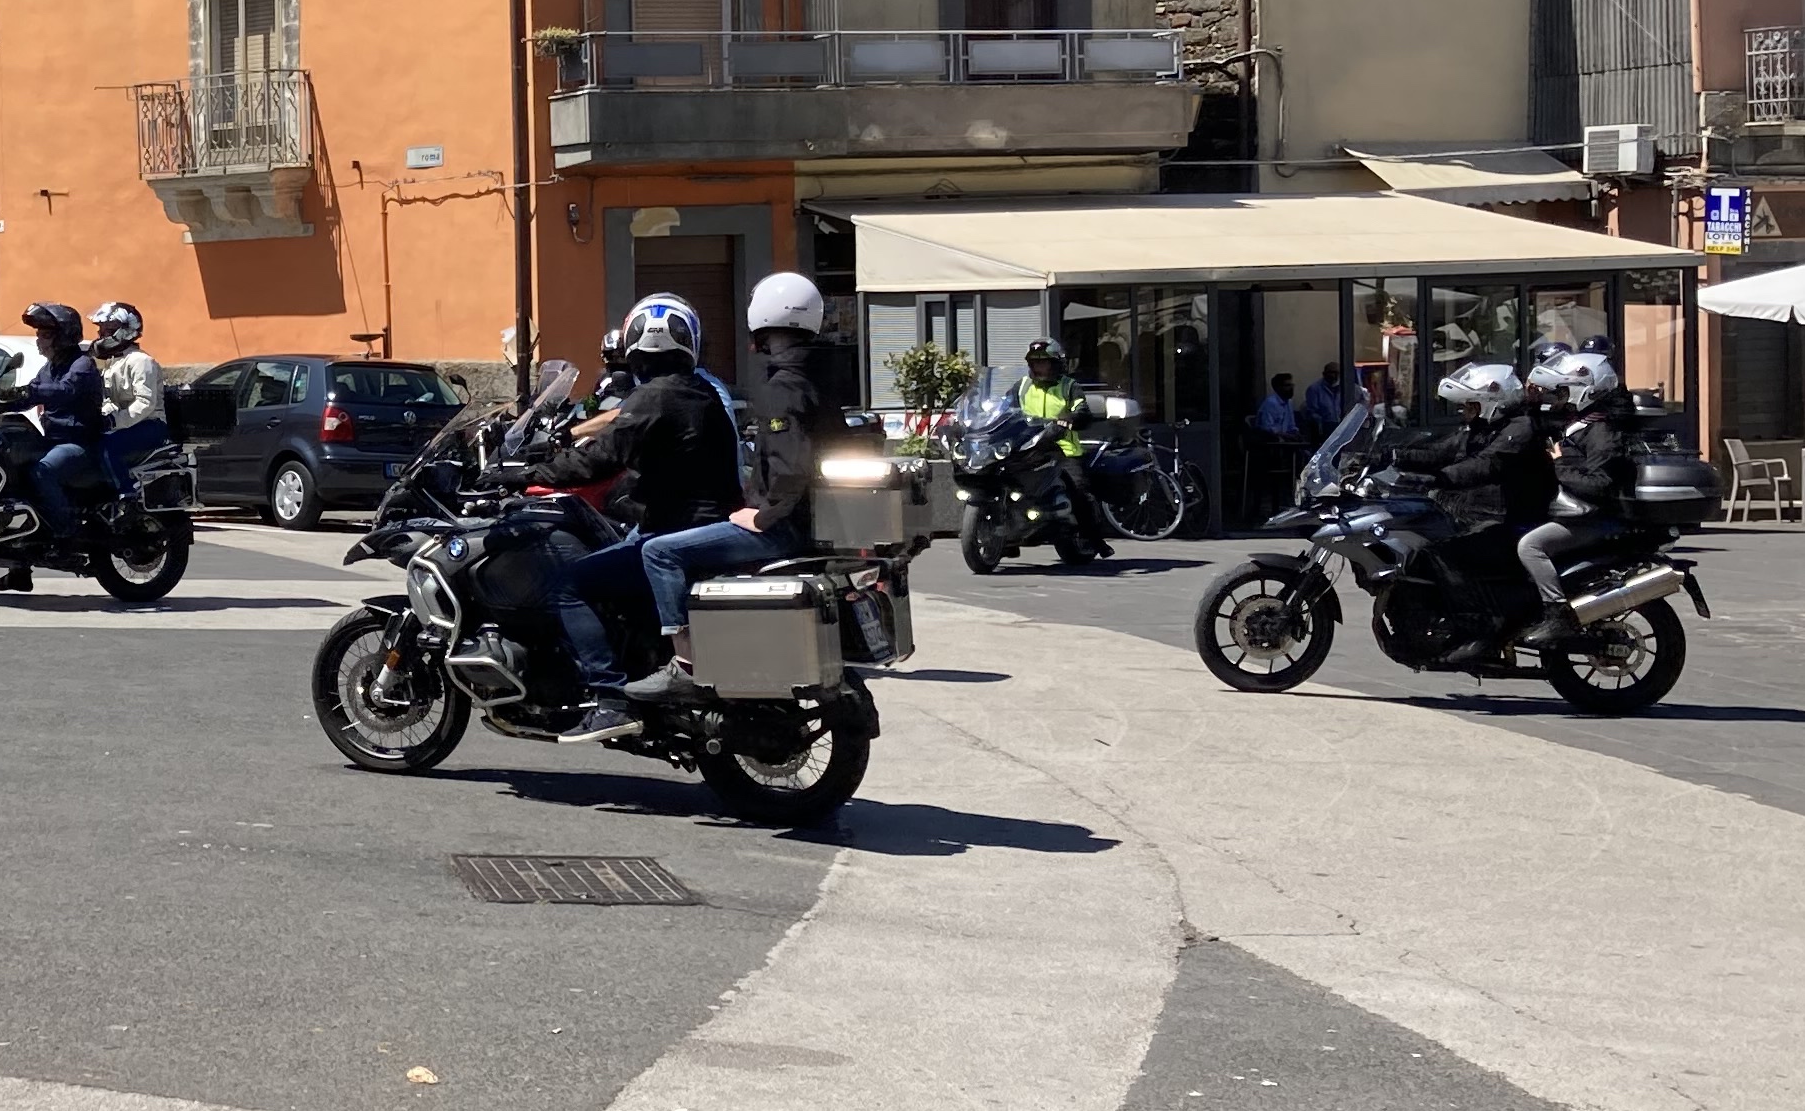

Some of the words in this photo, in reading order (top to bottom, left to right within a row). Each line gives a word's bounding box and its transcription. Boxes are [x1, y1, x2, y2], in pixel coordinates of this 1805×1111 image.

[1711, 188, 1740, 222] T
[1707, 222, 1742, 232] TABACCHI
[1707, 233, 1741, 241] LOTTO
